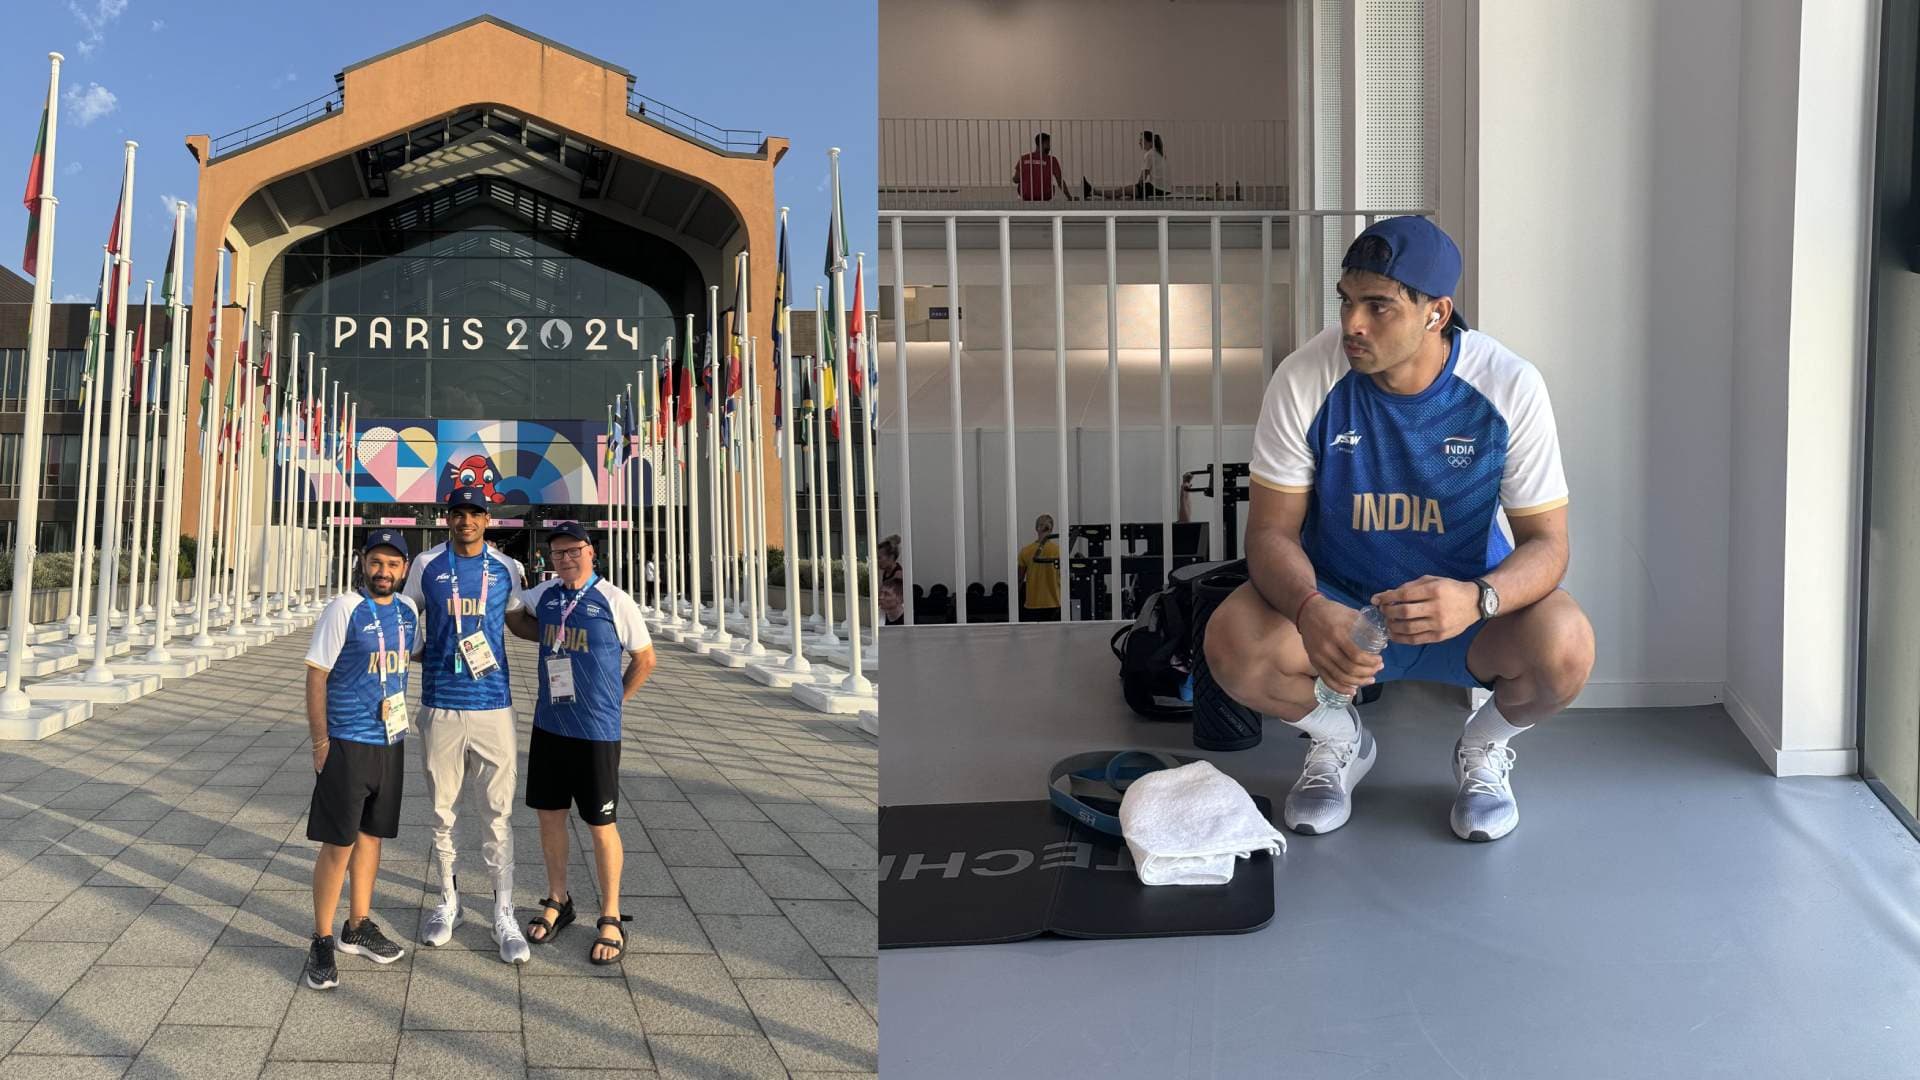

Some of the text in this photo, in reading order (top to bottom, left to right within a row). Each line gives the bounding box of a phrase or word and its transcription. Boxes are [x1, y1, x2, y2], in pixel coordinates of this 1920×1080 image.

[506, 317, 638, 350] 2024
[1445, 444, 1475, 455] INDIA
[1352, 493, 1445, 534] INDIA
